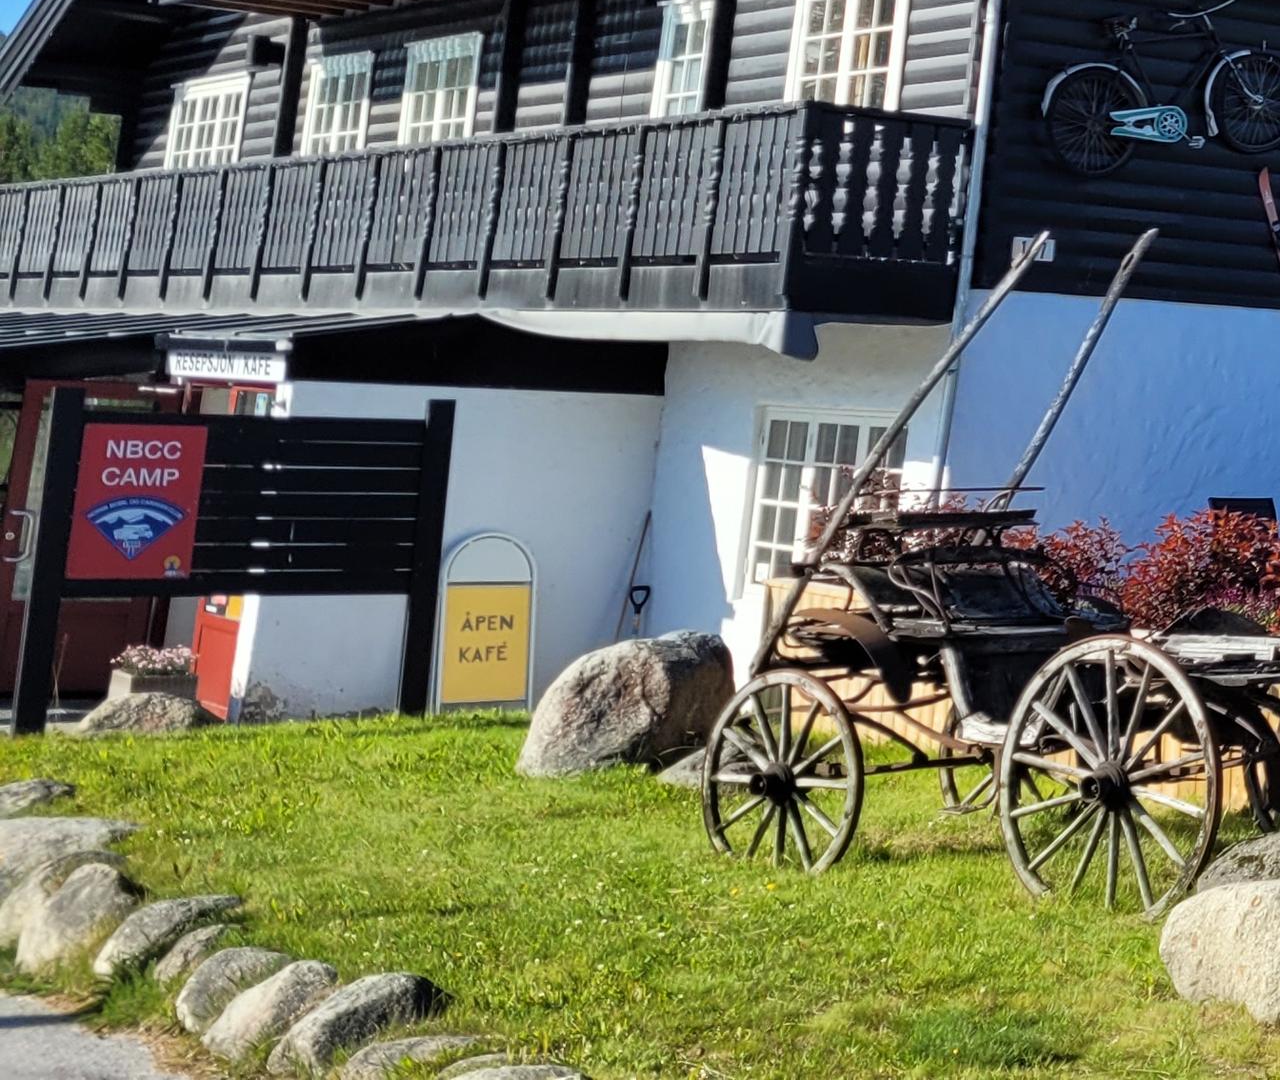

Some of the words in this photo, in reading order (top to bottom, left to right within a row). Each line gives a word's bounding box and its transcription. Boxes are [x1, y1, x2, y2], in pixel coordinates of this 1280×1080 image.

[175, 352, 235, 374] RESEPSJON
[106, 439, 182, 459] NBCC
[101, 467, 180, 486] CAMP
[461, 611, 514, 632] ÅPEN
[458, 641, 508, 663] KAFÉ
